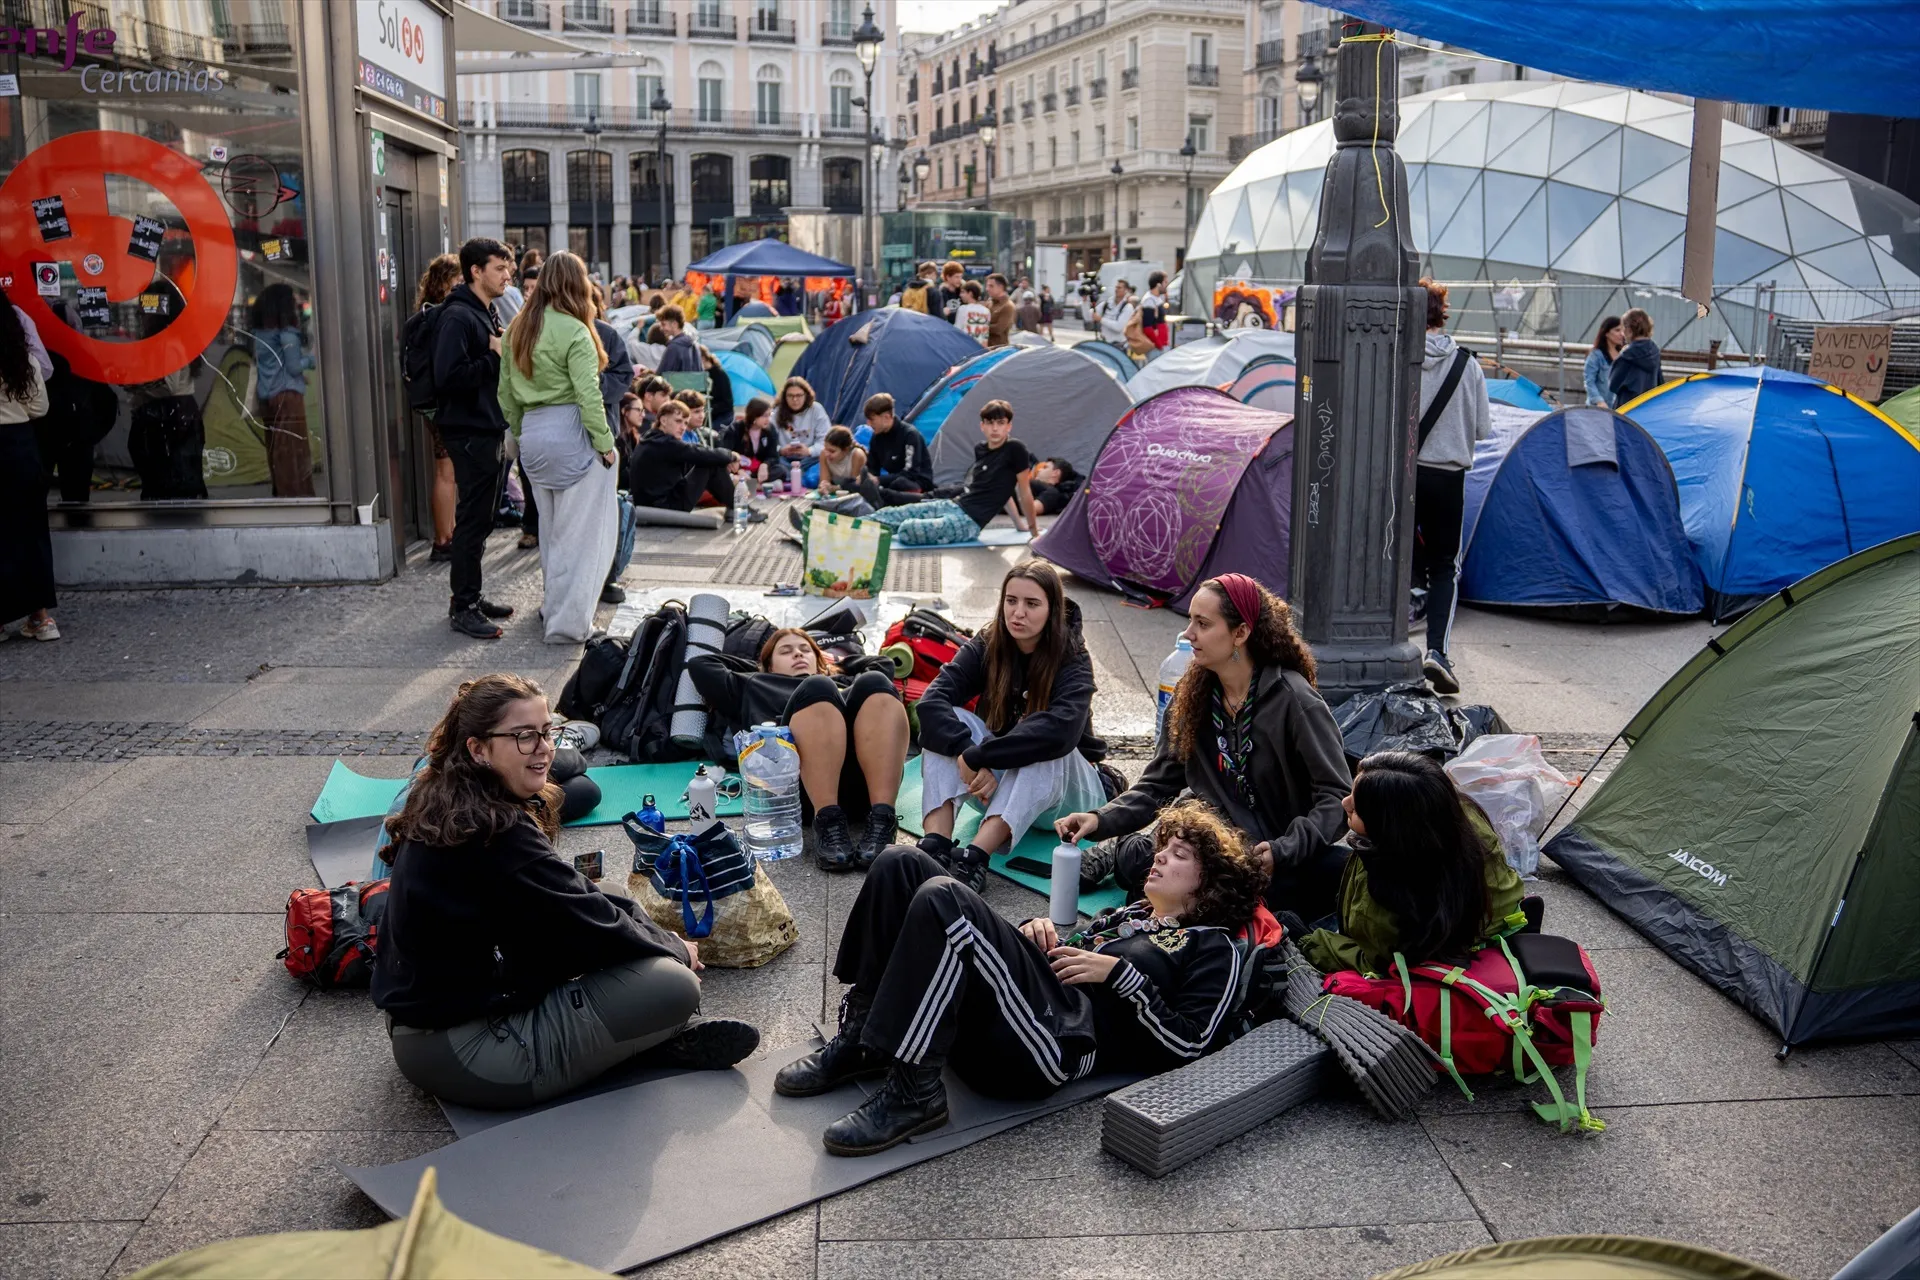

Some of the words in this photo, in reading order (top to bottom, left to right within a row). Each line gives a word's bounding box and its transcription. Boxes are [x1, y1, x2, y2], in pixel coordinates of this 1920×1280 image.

[378, 0, 400, 53] Sol
[0, 10, 117, 72] enfe
[80, 61, 225, 93] Cercanías
[1816, 332, 1889, 350] VIVIENDA
[1812, 352, 1856, 369] BAJO
[1147, 443, 1212, 463] Quechua
[816, 636, 845, 645] chua
[1667, 848, 1727, 887] JAICOM
